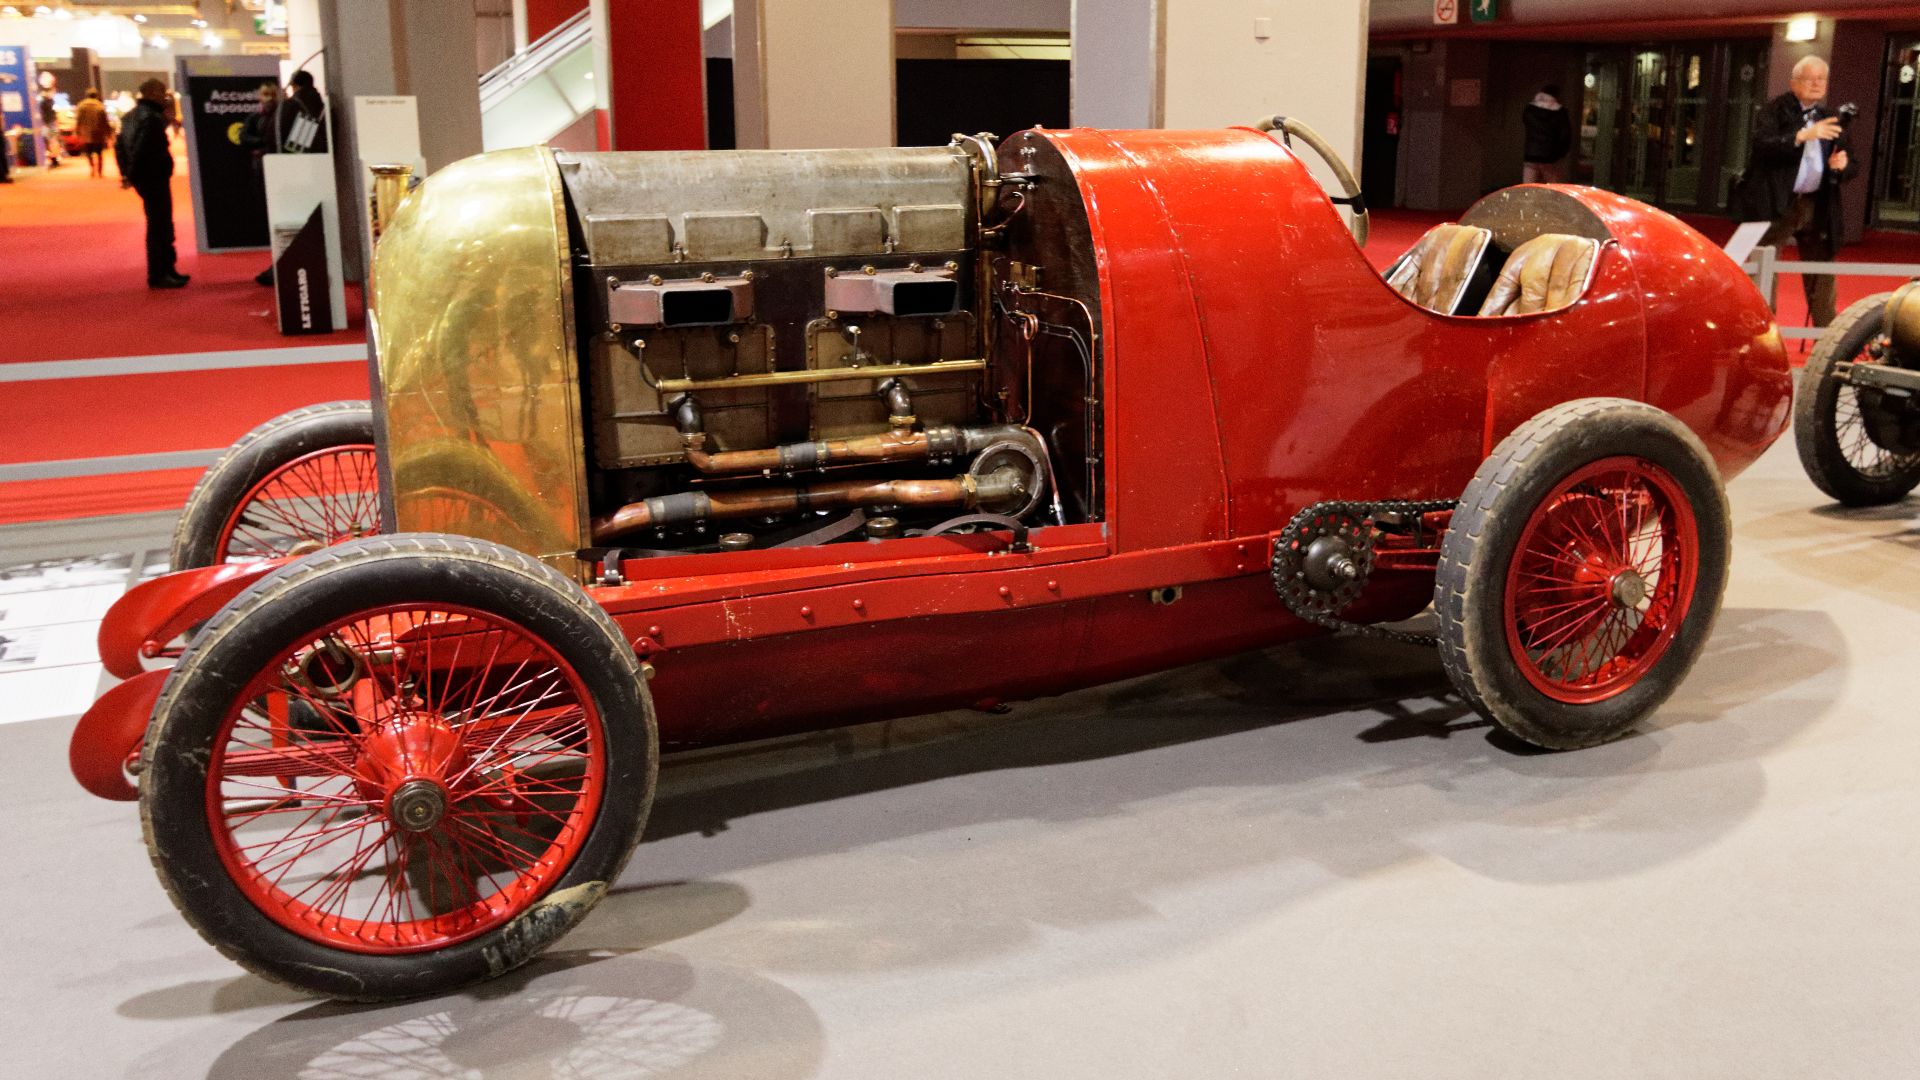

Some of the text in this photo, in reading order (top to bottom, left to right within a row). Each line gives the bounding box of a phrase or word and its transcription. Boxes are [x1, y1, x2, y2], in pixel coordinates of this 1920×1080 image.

[204, 102, 263, 115] Exposan
[297, 268, 311, 329] LE FIGARO
